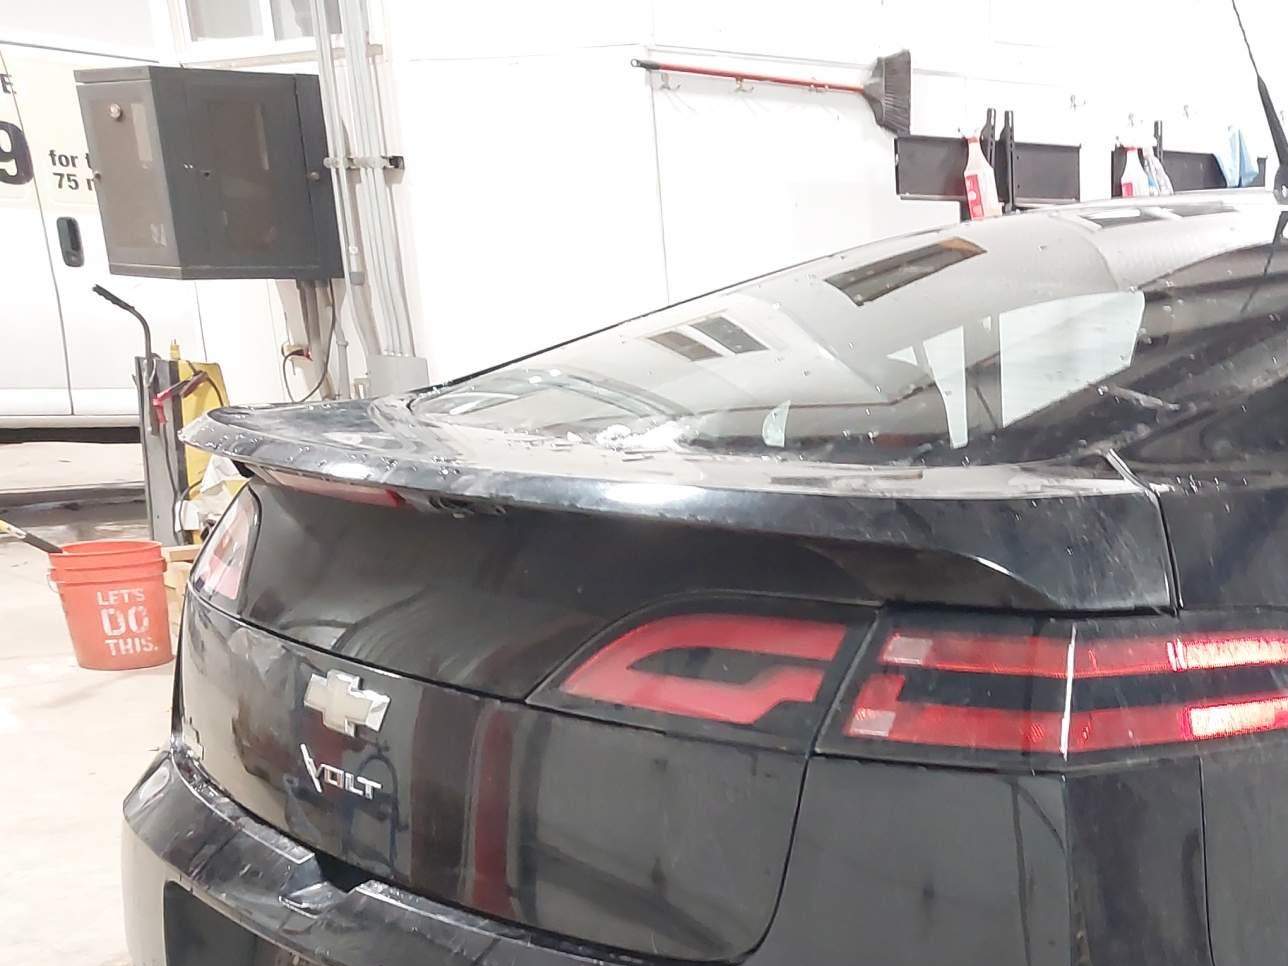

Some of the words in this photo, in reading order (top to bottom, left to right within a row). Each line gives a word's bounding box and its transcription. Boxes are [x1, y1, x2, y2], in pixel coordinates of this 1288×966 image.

[48, 149, 79, 168] for
[52, 172, 80, 191] 75
[101, 605, 150, 636] DO
[104, 636, 159, 657] THIS.
[300, 743, 383, 800] VOLT
